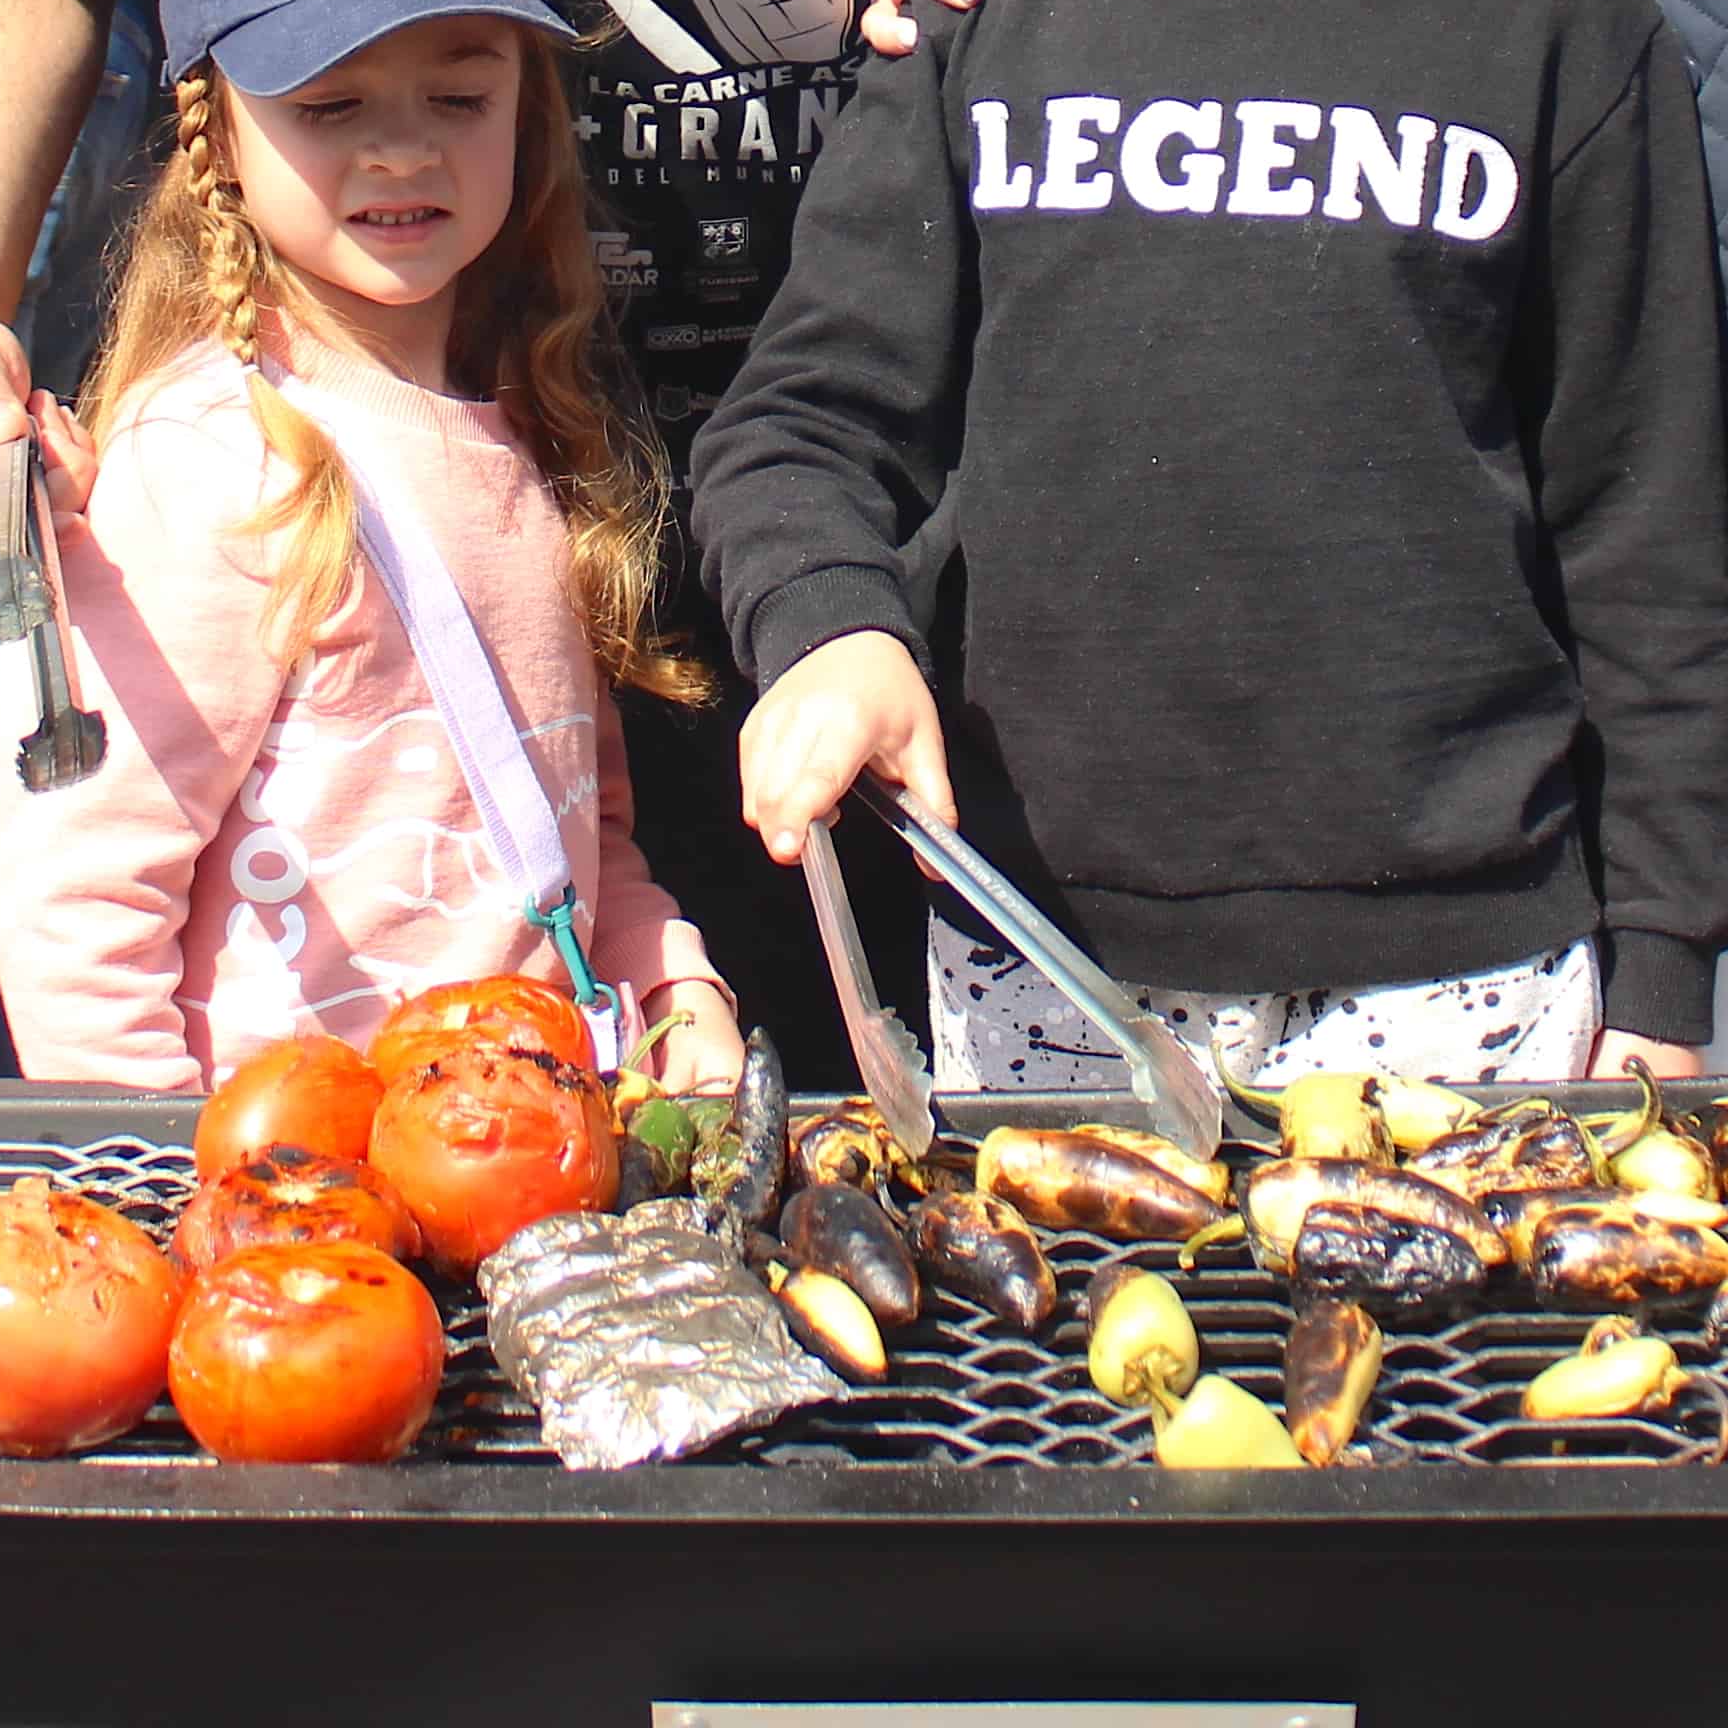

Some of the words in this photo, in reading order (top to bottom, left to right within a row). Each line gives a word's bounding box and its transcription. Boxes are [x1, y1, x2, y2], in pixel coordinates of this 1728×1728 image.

[587, 75, 641, 99] LA
[653, 64, 796, 104] CARNE
[608, 167, 671, 186] DEL
[969, 94, 1520, 242] LEGEND
